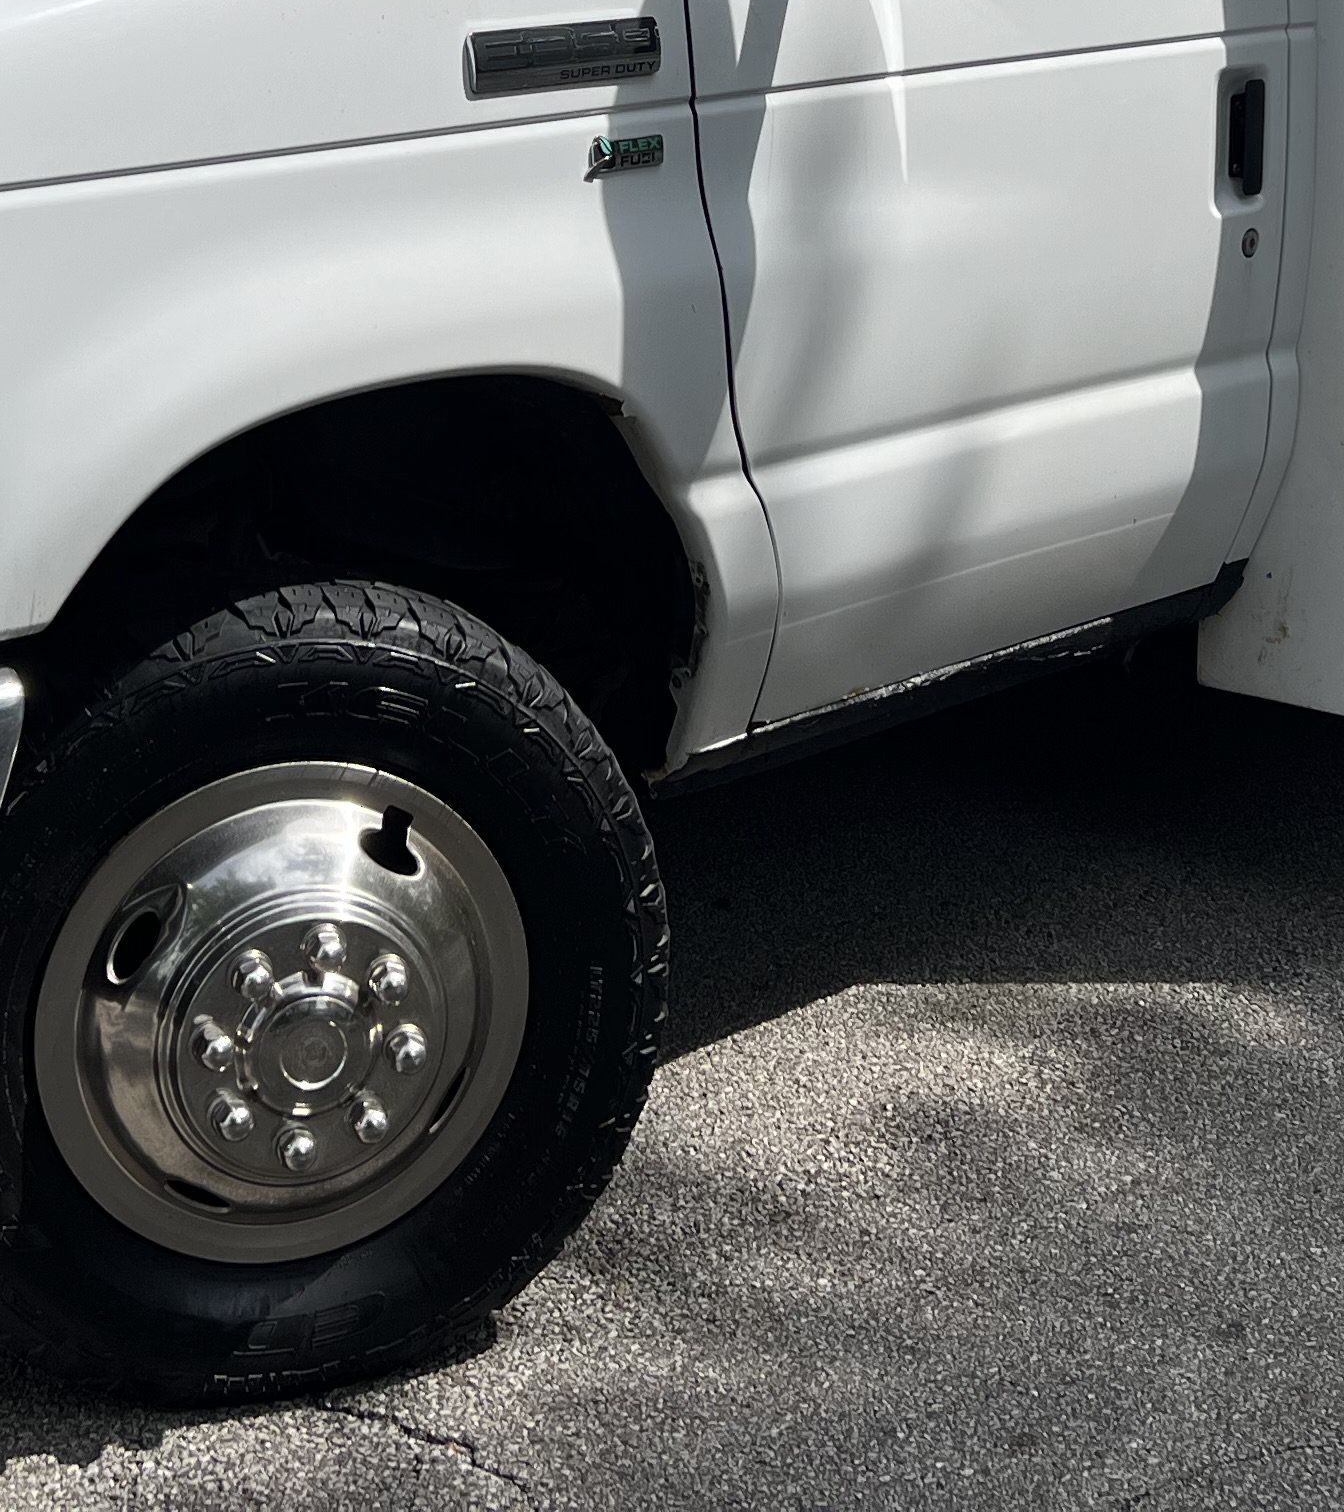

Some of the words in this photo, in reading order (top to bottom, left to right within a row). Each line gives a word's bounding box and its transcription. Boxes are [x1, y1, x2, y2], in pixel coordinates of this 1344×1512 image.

[560, 64, 611, 80] SUPER
[615, 60, 656, 73] DUTY
[619, 136, 661, 154] FLEX
